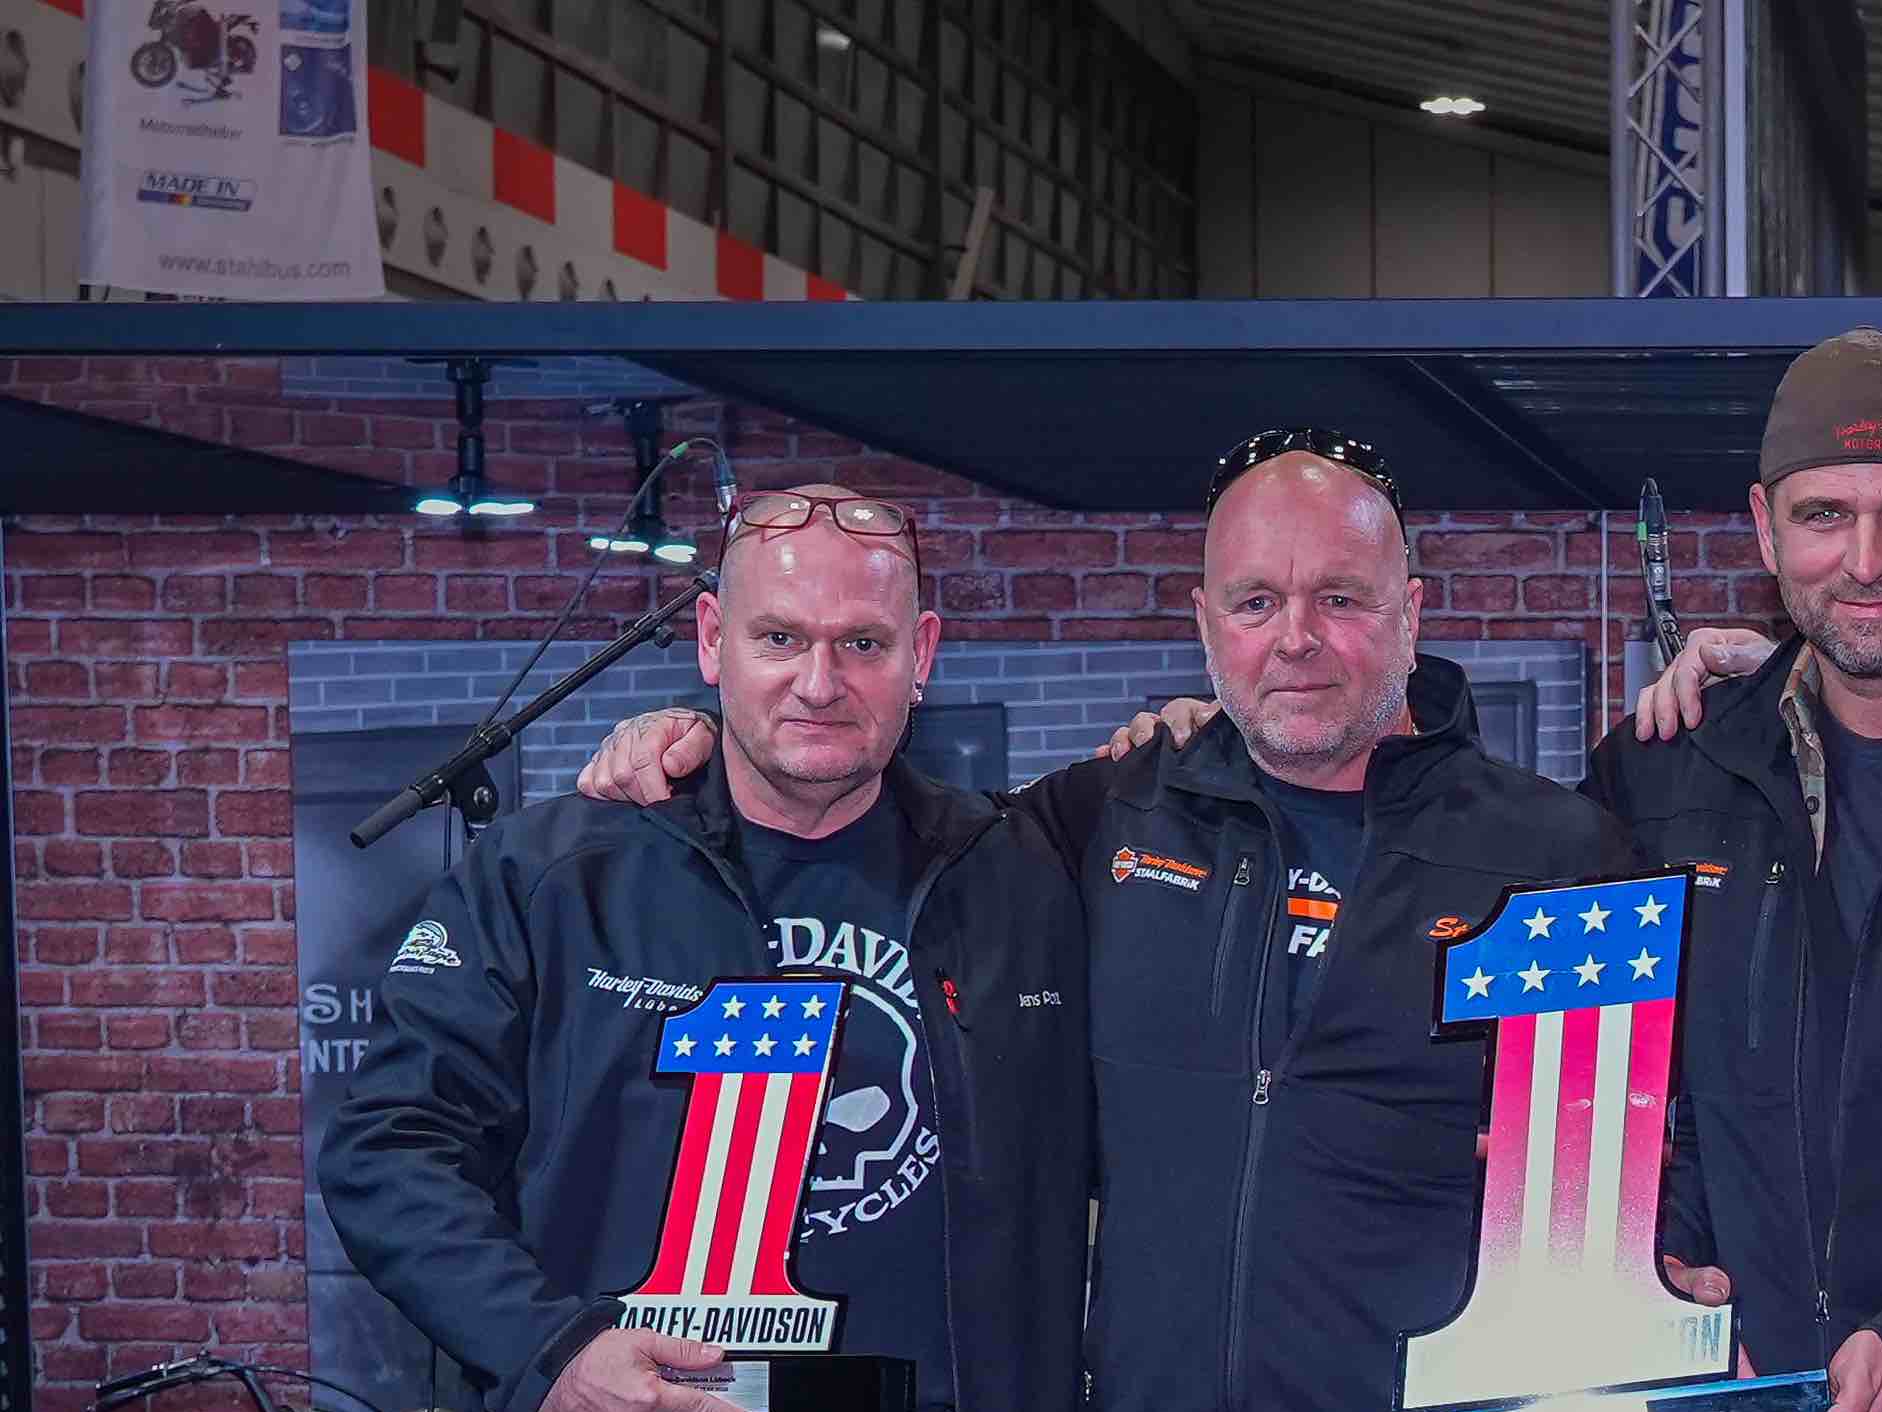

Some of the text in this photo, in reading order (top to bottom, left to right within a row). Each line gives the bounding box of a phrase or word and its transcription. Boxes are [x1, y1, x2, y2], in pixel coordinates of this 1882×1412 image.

[147, 173, 240, 196] MADE IN
[158, 253, 351, 280] www.stahlbus.com
